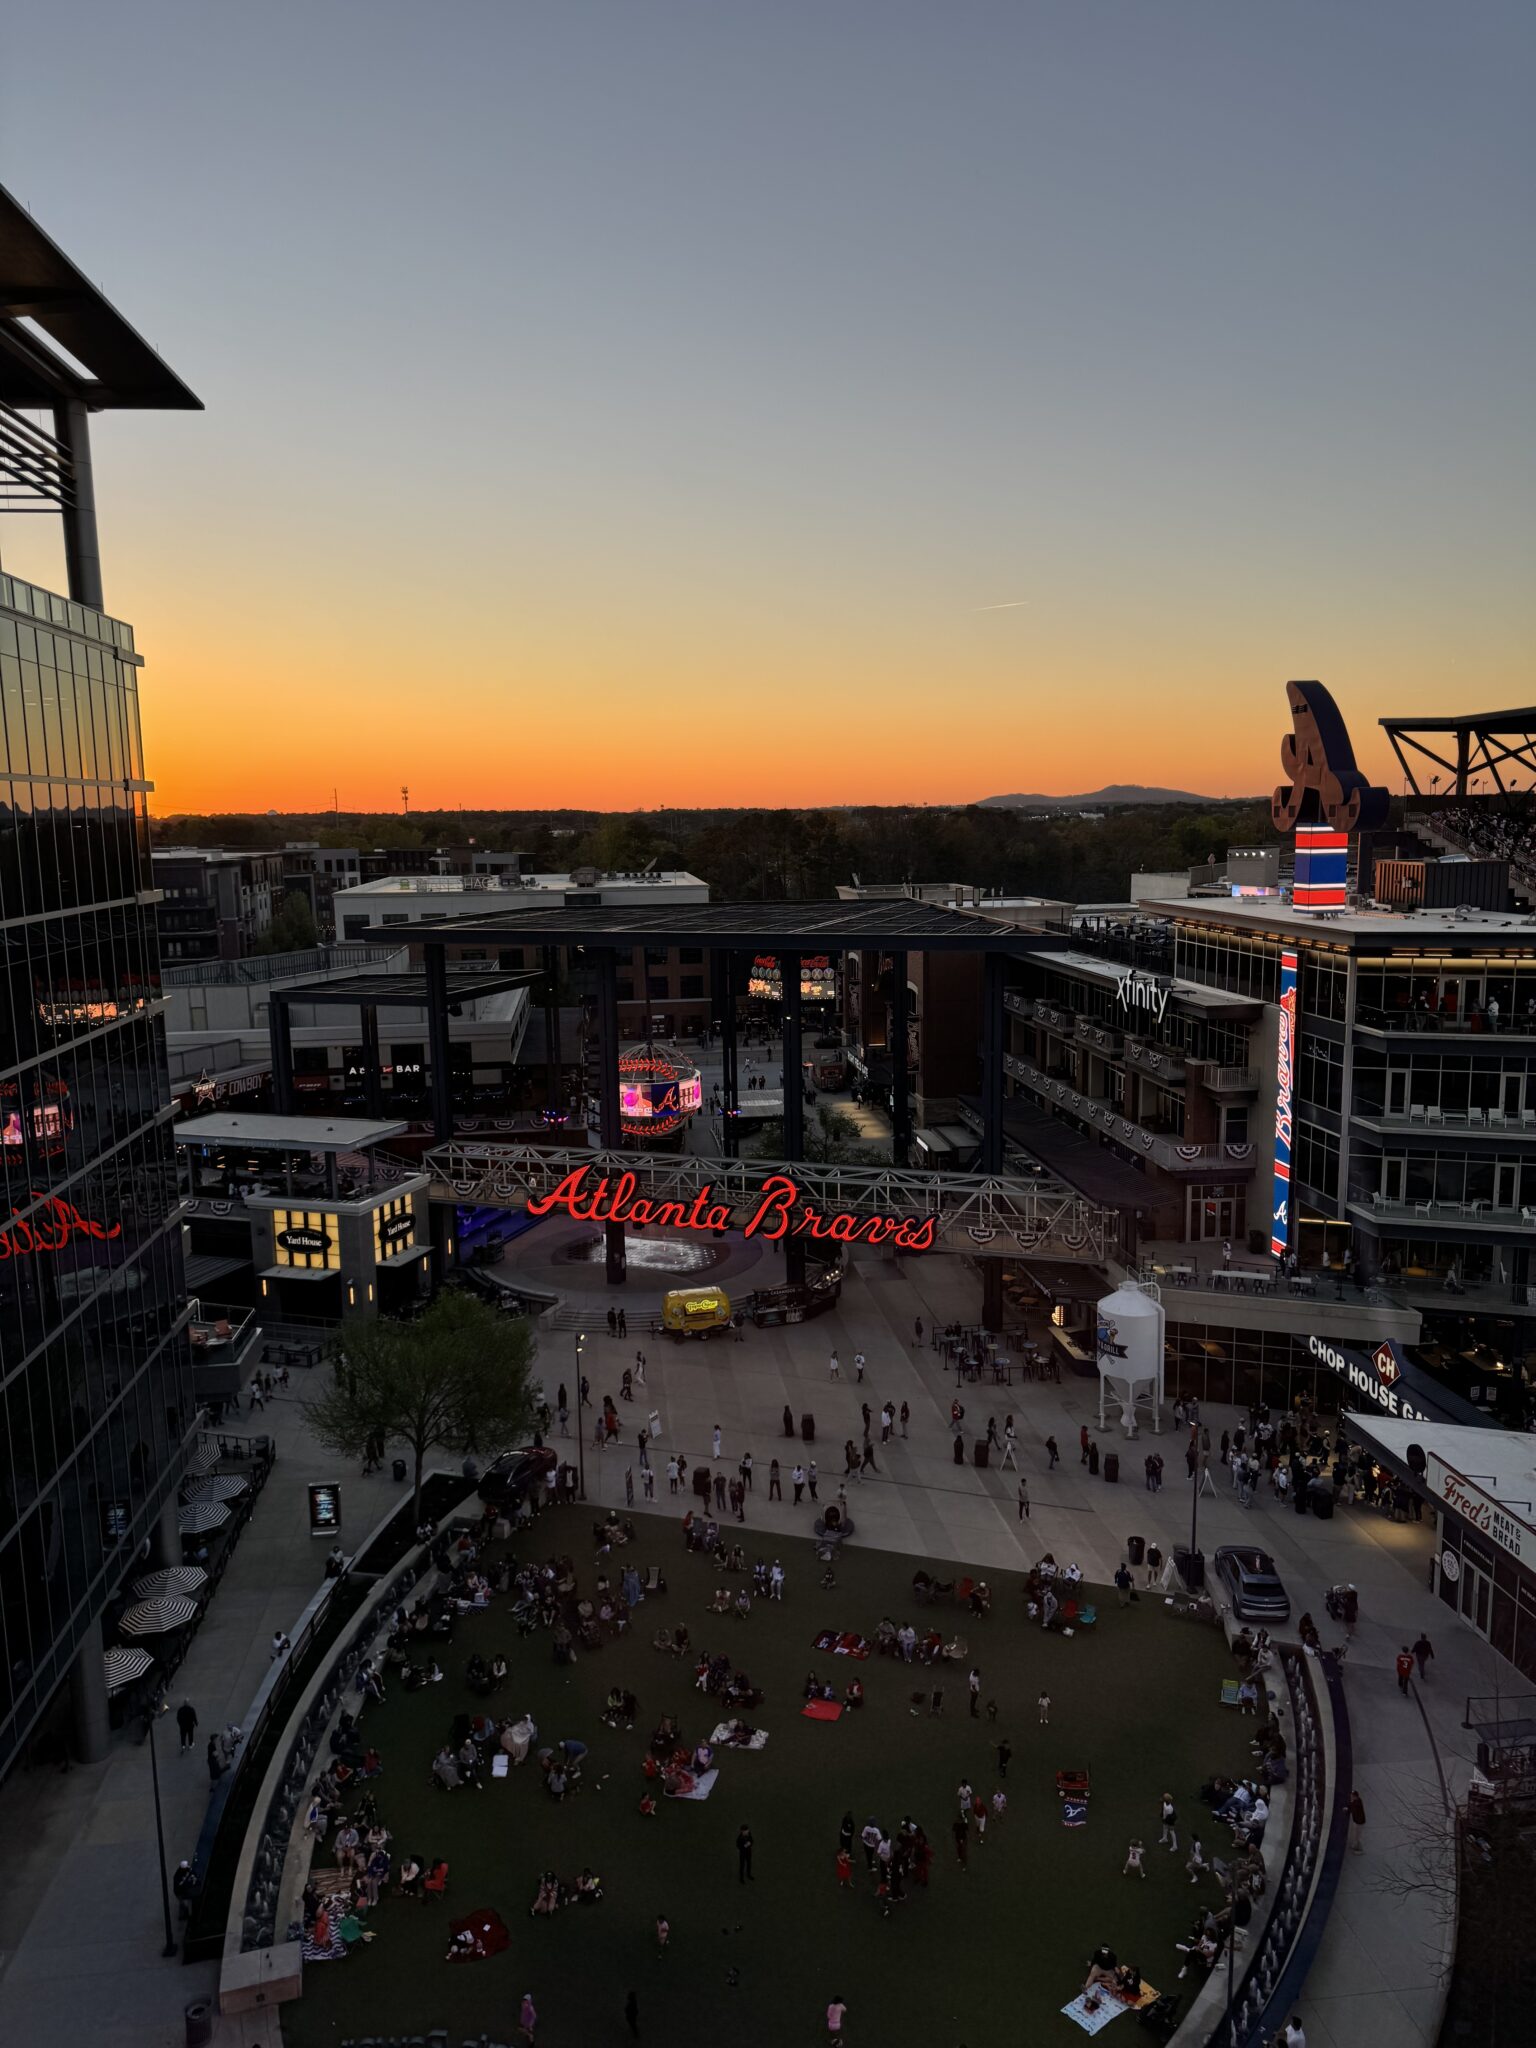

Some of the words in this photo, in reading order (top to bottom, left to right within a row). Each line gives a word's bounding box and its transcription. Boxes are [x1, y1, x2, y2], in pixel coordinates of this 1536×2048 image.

[1116, 969, 1168, 1024] xfinity
[395, 1064, 420, 1073] BAR
[229, 1074, 263, 1096] COWBOY
[527, 1163, 733, 1230] Atlanta
[743, 1174, 940, 1252] Braves
[1273, 1200, 1288, 1225] A
[286, 1234, 301, 1245] Yard
[302, 1236, 323, 1247] House
[387, 1225, 398, 1236] Yard
[397, 1219, 412, 1232] House
[1309, 1335, 1346, 1373] CHOP
[1349, 1361, 1399, 1416] HOUSE
[1377, 1352, 1396, 1380] CH
[1444, 1474, 1492, 1531] Fred's
[1493, 1510, 1515, 1535] MEAT
[1492, 1526, 1521, 1556] BREAD
